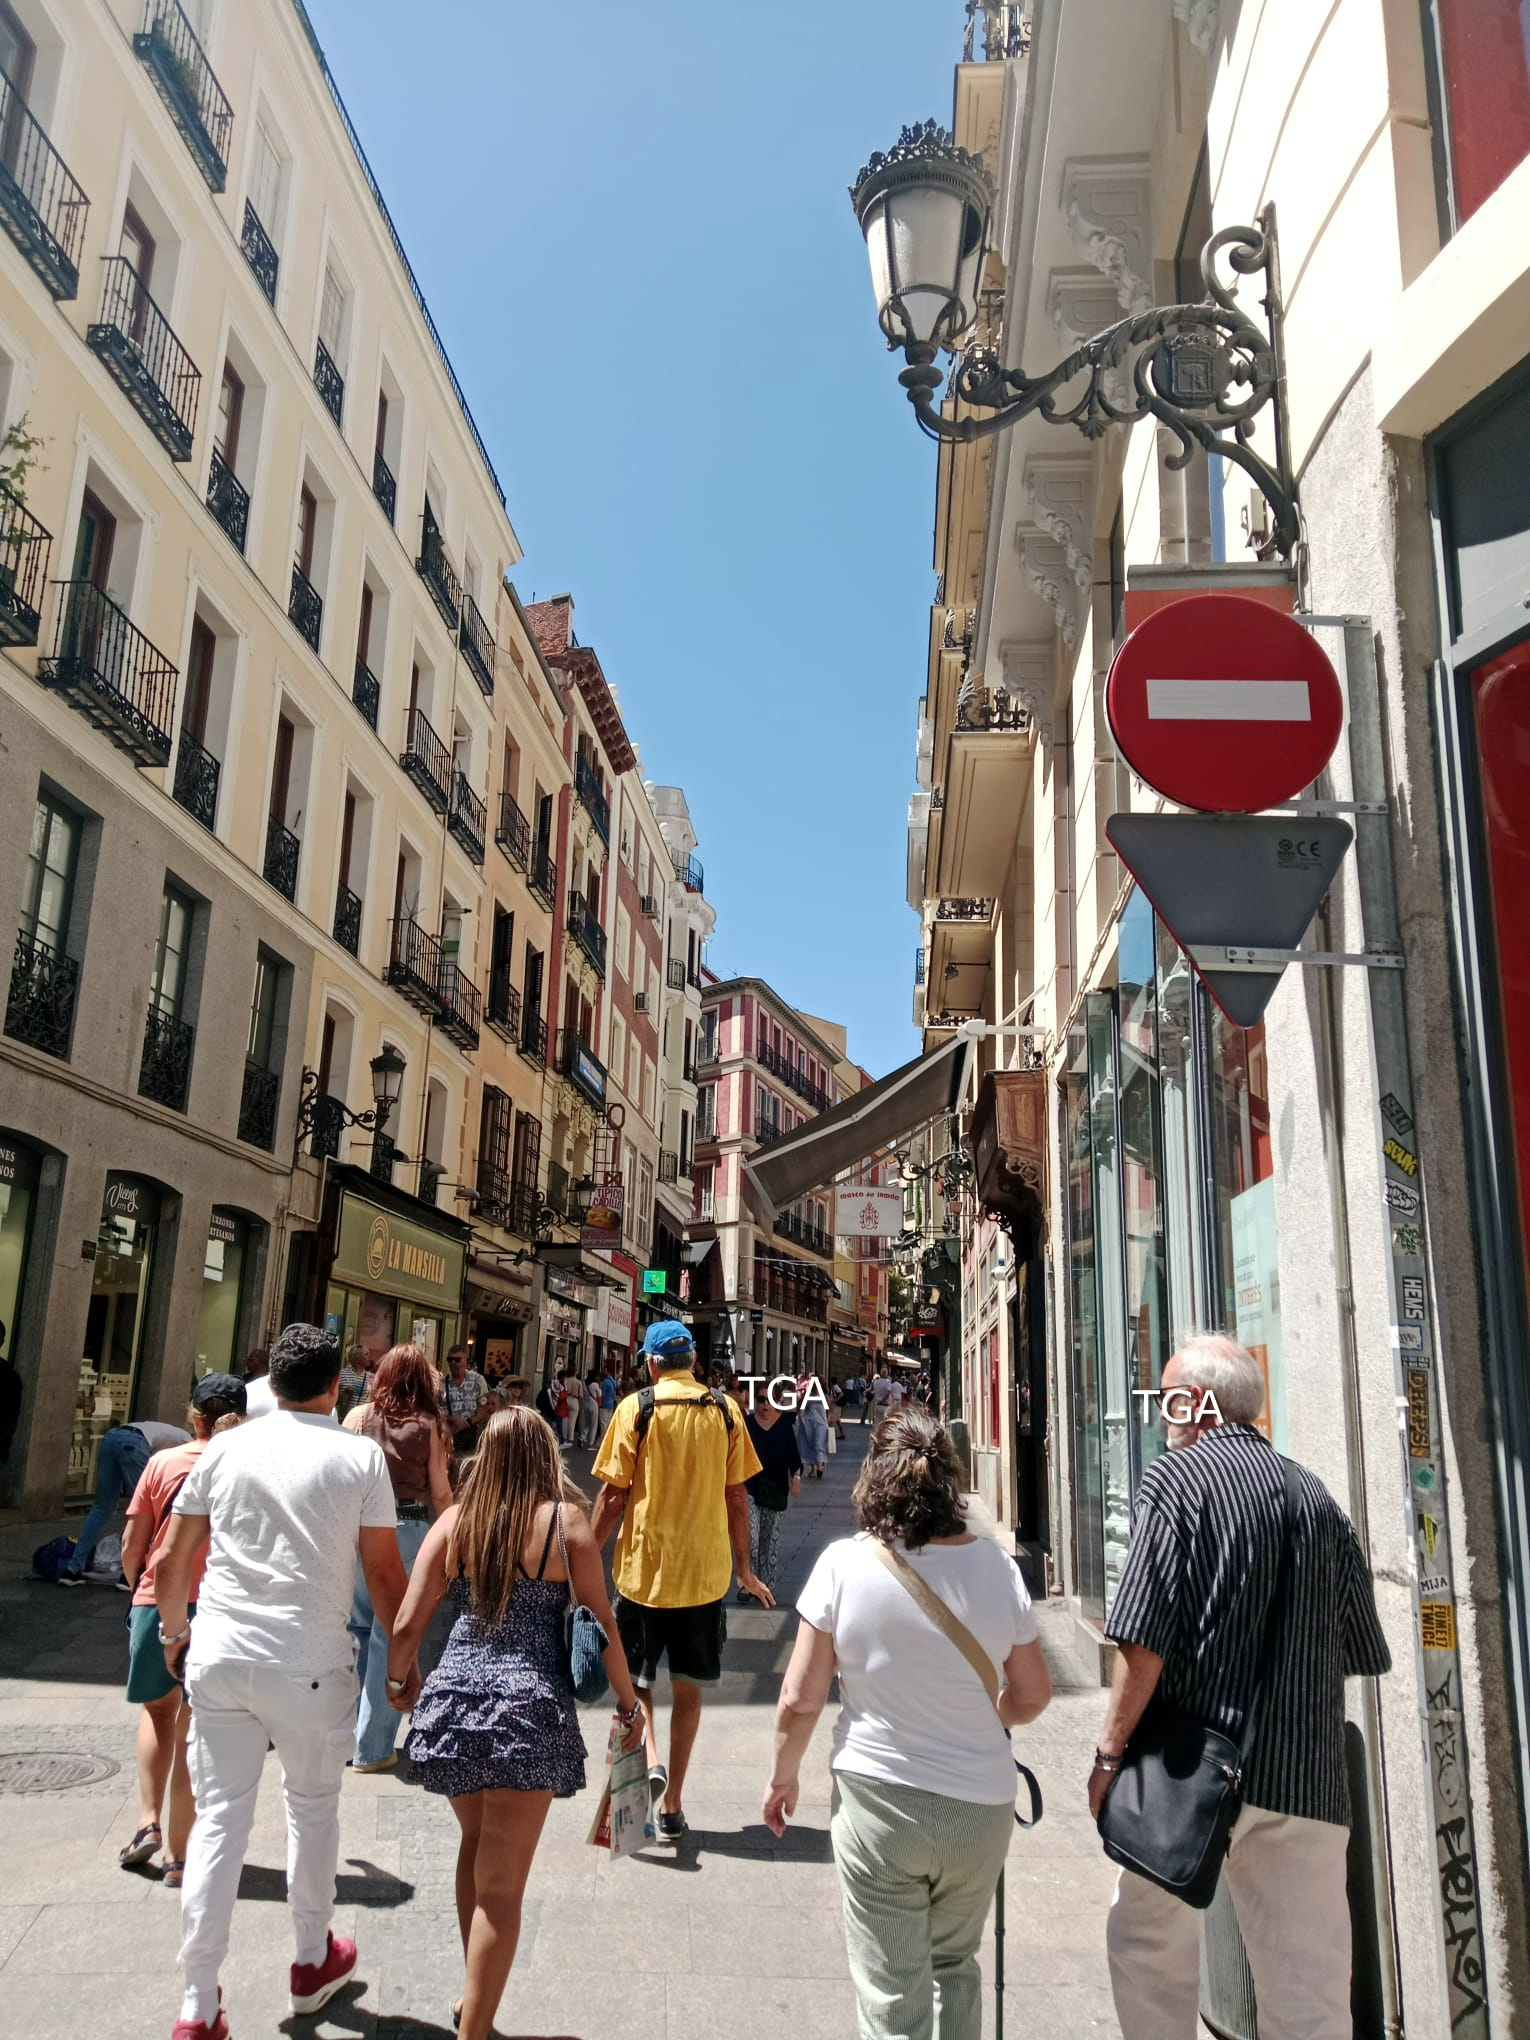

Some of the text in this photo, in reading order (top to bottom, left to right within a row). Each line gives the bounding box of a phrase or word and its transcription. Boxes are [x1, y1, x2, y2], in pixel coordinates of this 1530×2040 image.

[388, 1238, 401, 1270] LA
[402, 1243, 446, 1285] MANSILLA
[1404, 1279, 1423, 1319] HEMS
[1421, 1577, 1448, 1592] MIJA
[1421, 1603, 1436, 1648] TWICE
